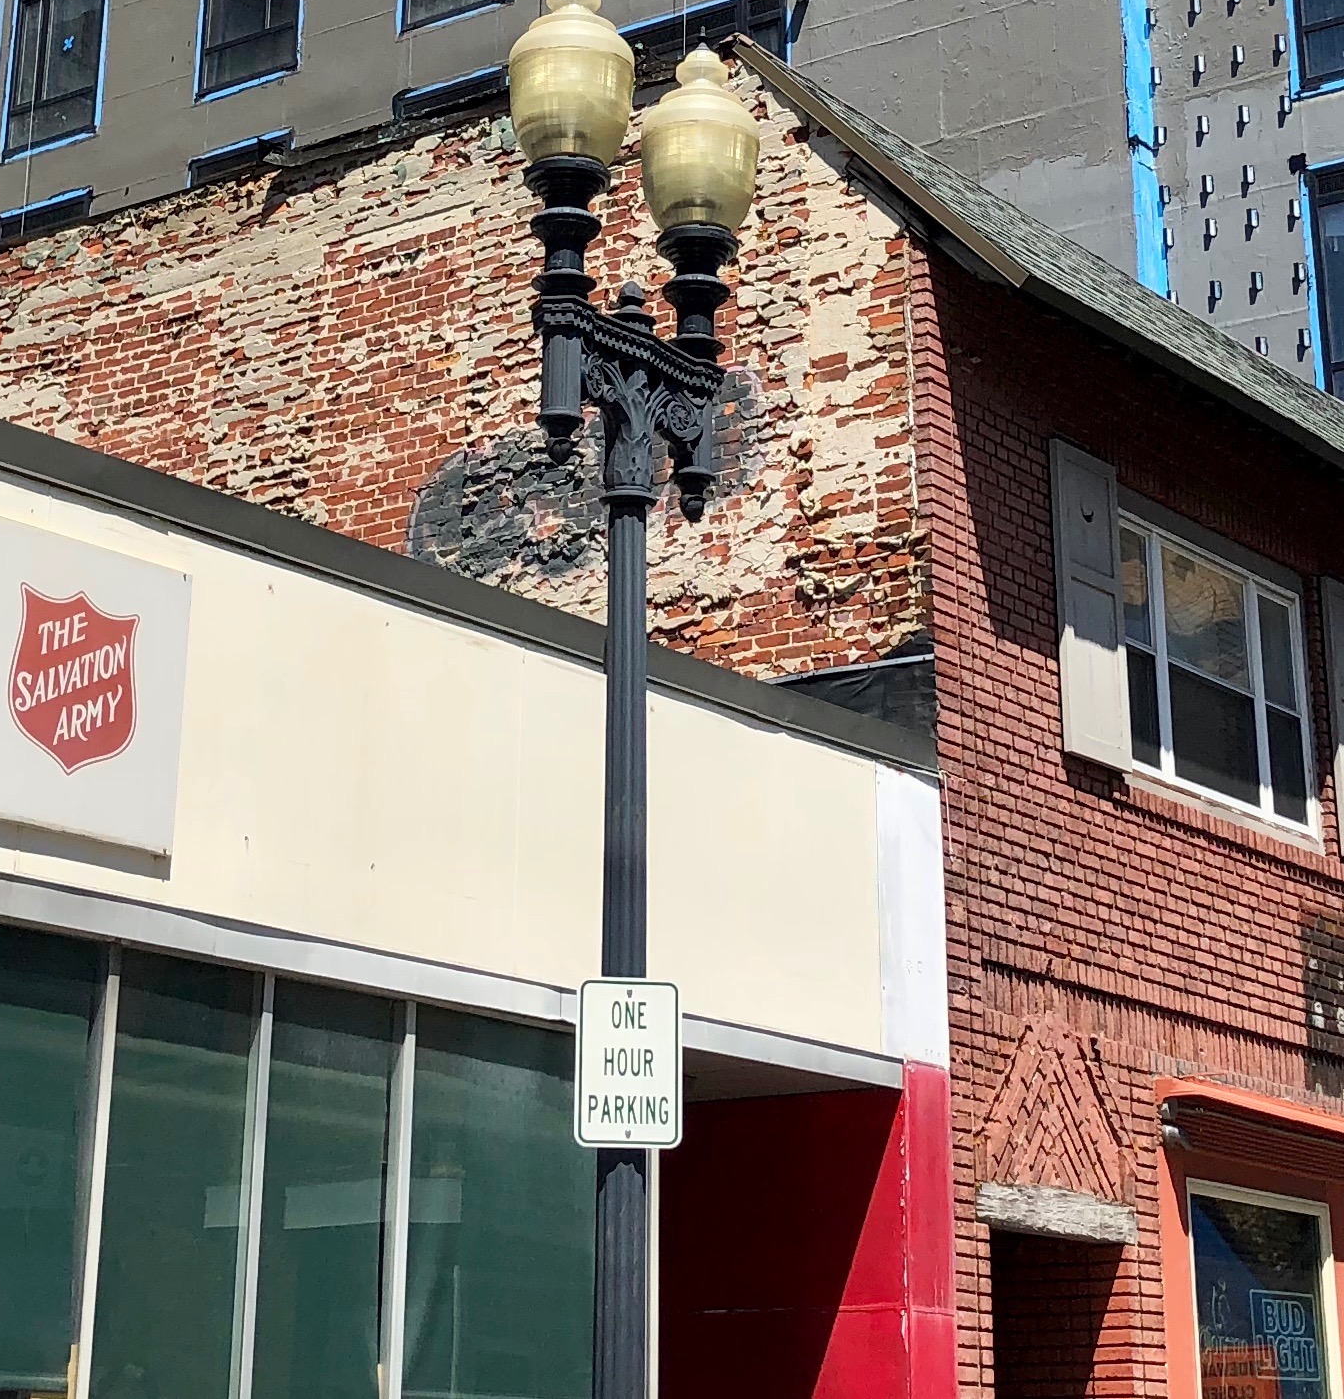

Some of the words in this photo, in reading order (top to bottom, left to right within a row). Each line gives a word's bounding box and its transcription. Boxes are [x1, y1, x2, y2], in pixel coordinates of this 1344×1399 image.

[38, 611, 89, 656] THE
[15, 635, 128, 712] SALVATION
[52, 684, 123, 746] ARMY
[611, 1000, 647, 1030] ONE
[604, 1047, 654, 1078] HOUR
[587, 1095, 670, 1126] PARKING
[1262, 1298, 1306, 1335] BUD
[1255, 1334, 1316, 1373] LIGHT
